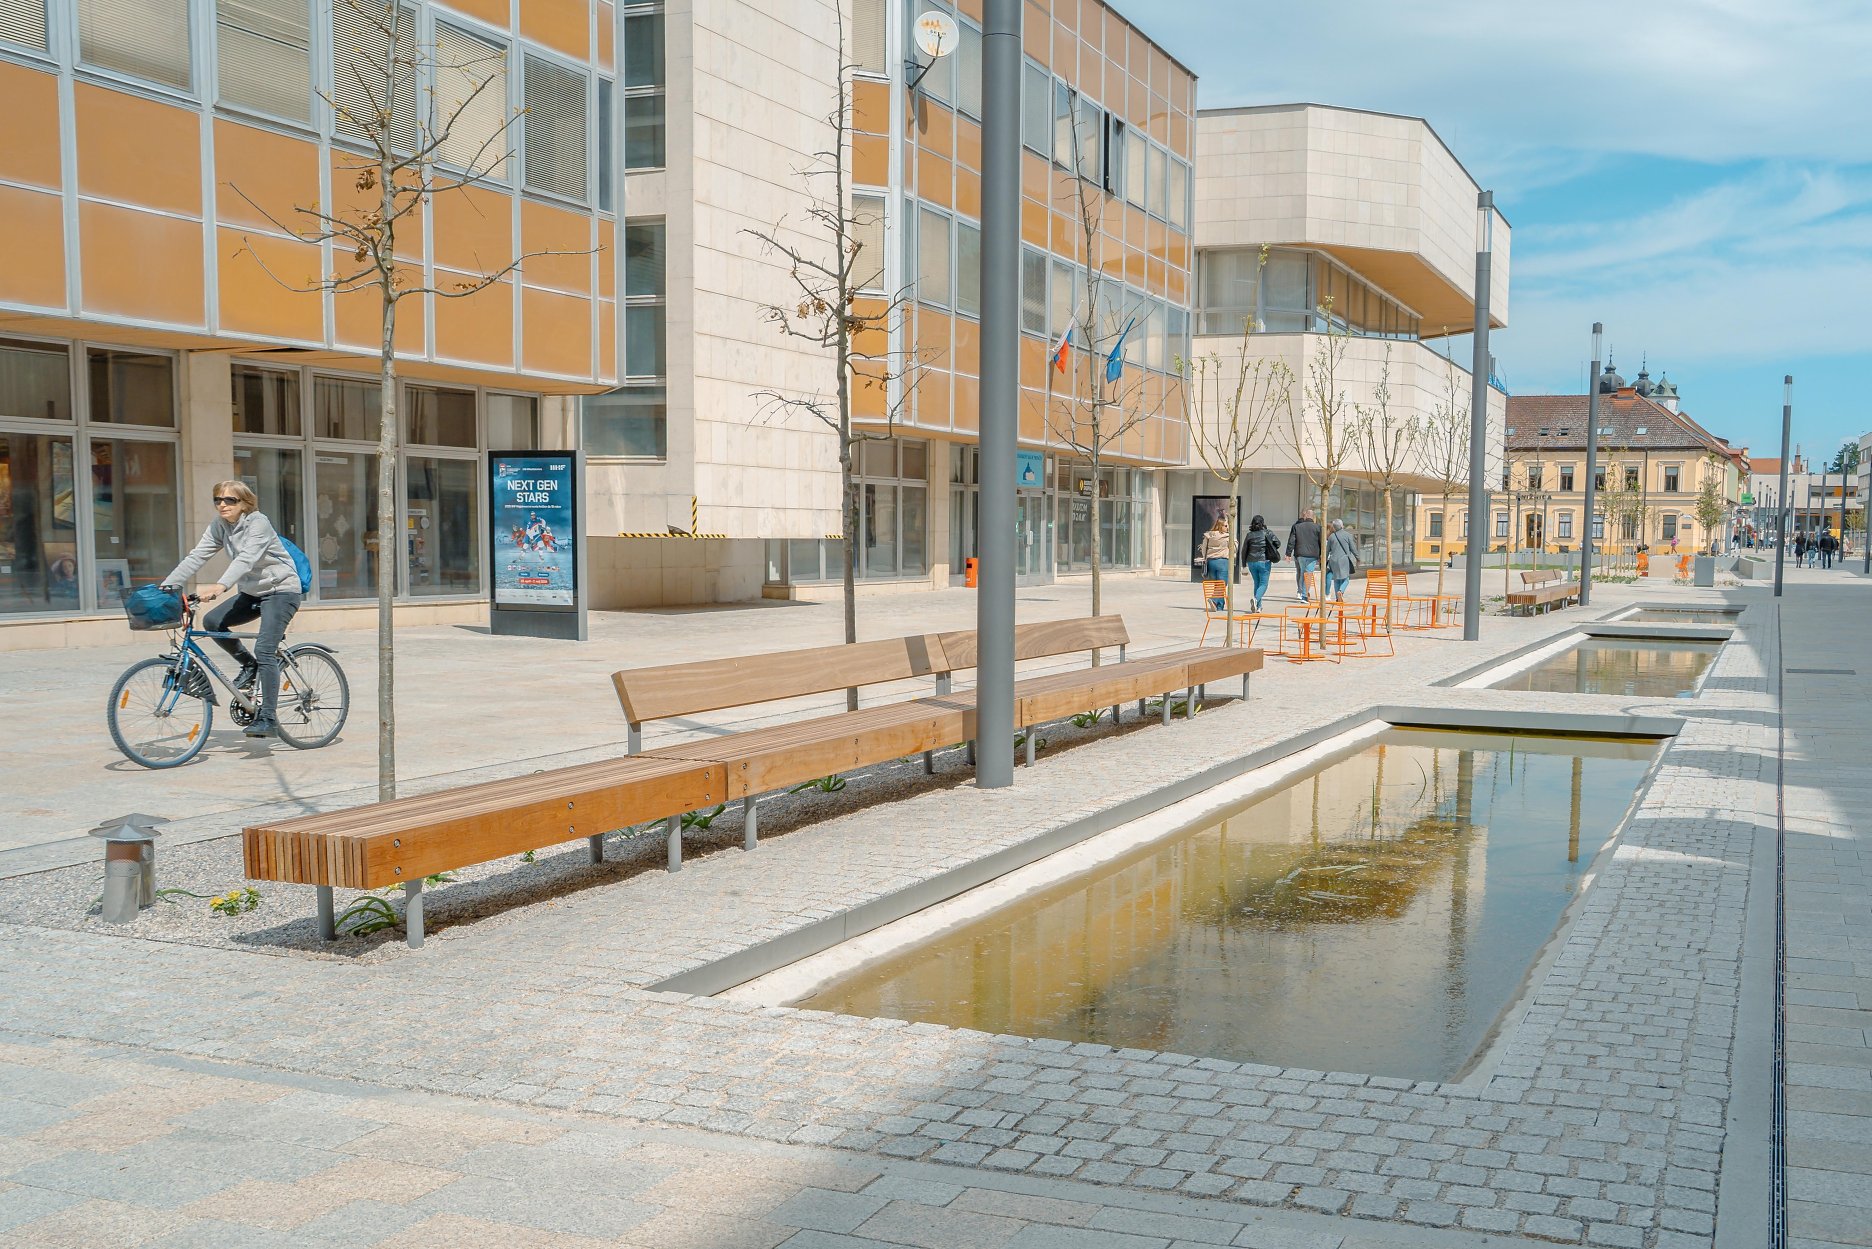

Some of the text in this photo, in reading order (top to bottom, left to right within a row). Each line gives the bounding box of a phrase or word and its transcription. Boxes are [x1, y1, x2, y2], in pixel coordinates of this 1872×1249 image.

[507, 479, 558, 491] NEXT GEN
[516, 492, 549, 503] STARS
